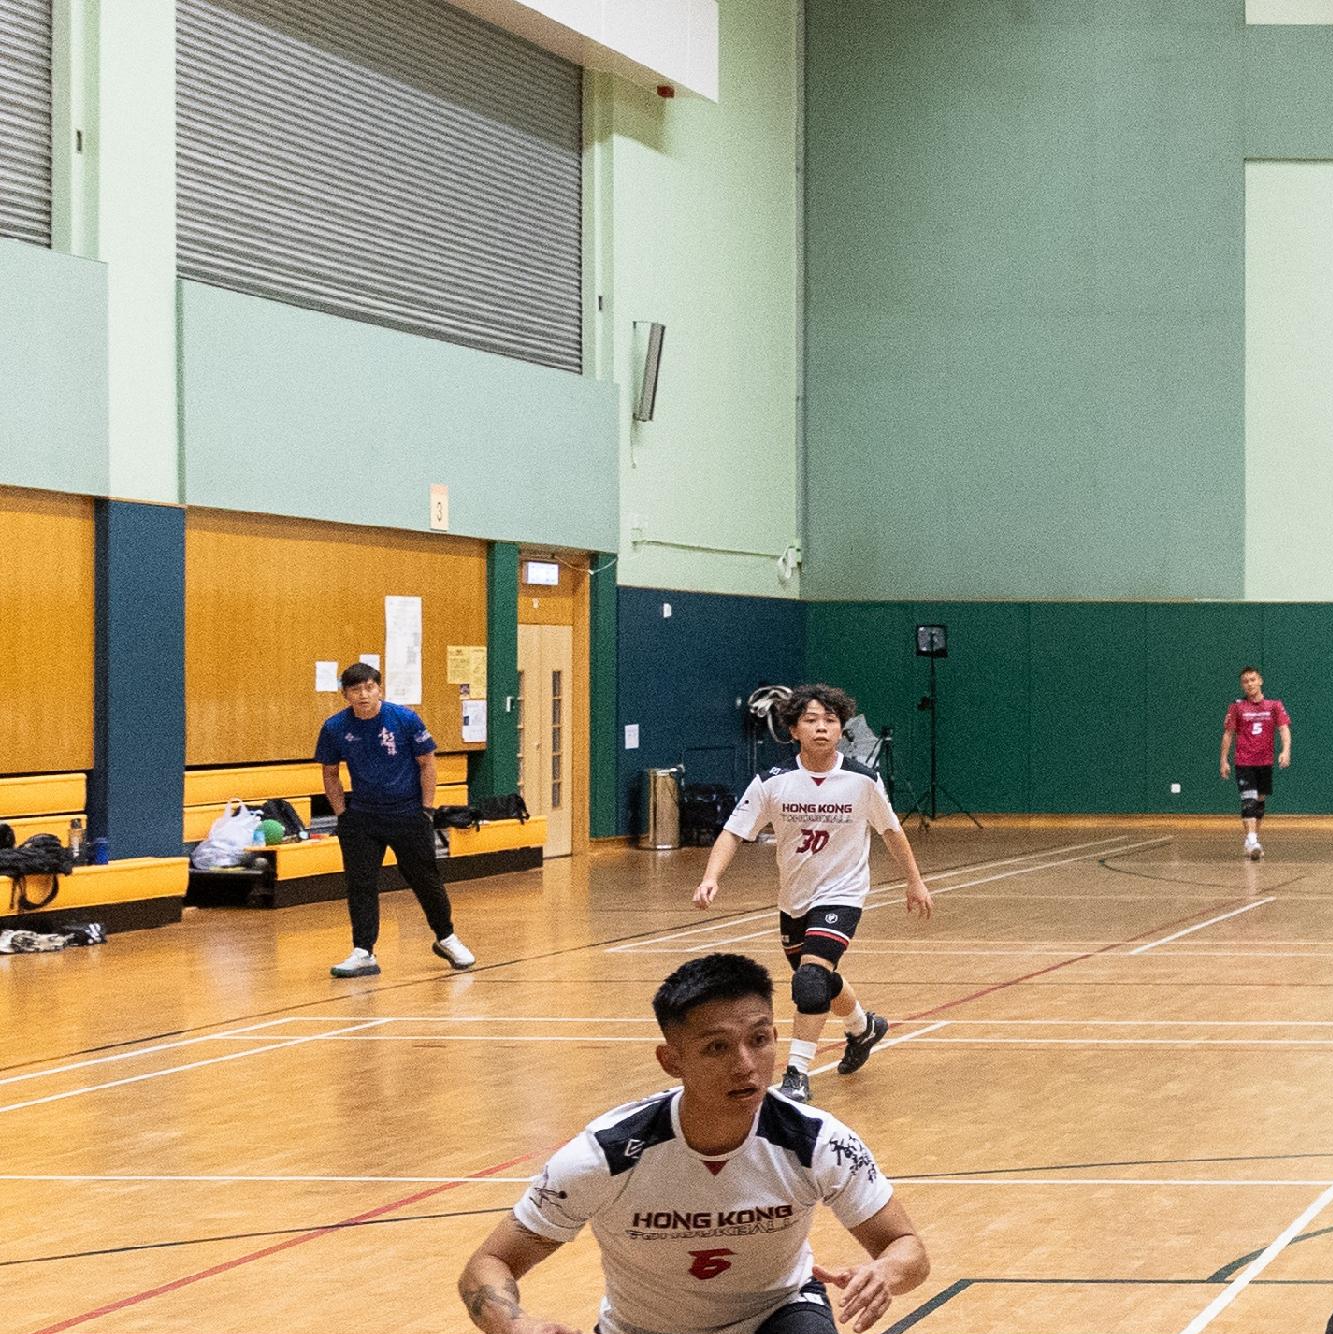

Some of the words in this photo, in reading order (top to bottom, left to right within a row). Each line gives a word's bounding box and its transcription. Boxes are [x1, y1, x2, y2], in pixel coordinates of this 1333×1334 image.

[436, 502, 442, 522] 3
[1251, 722, 1263, 735] 5
[782, 803, 817, 815] HONG
[817, 803, 854, 815] KONG
[795, 828, 831, 855] 30
[632, 1209, 712, 1231] HONG
[717, 1204, 794, 1227] KONG
